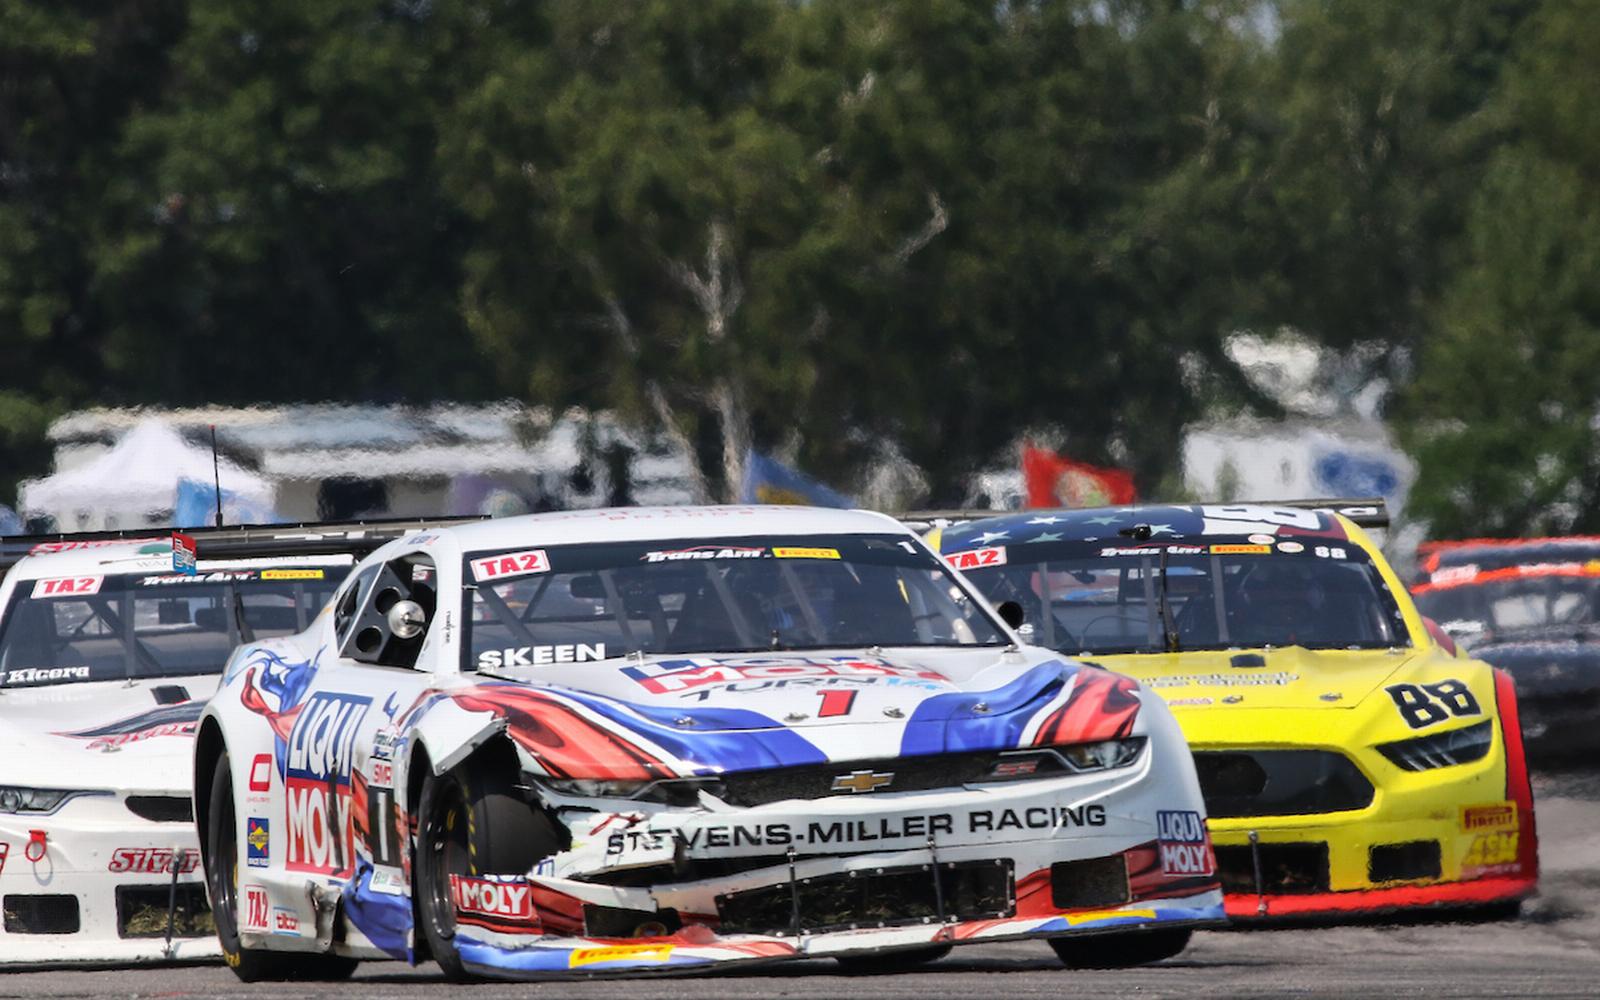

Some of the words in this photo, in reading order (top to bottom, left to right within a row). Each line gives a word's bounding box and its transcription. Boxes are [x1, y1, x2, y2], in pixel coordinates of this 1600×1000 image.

[480, 554, 541, 577] TA2
[946, 549, 999, 569] TA2
[1315, 546, 1347, 559] 88
[44, 578, 96, 594] TA2
[478, 643, 606, 668] SKEEN
[816, 689, 859, 718] 1
[1384, 679, 1482, 729] 88
[288, 696, 368, 779] LIQUI
[377, 791, 389, 862] 1
[969, 805, 1107, 832] RACING
[1159, 812, 1203, 842] LIQUI
[1163, 845, 1206, 872] MOLY
[248, 891, 268, 928] TA2
[461, 881, 528, 914] MOLY
